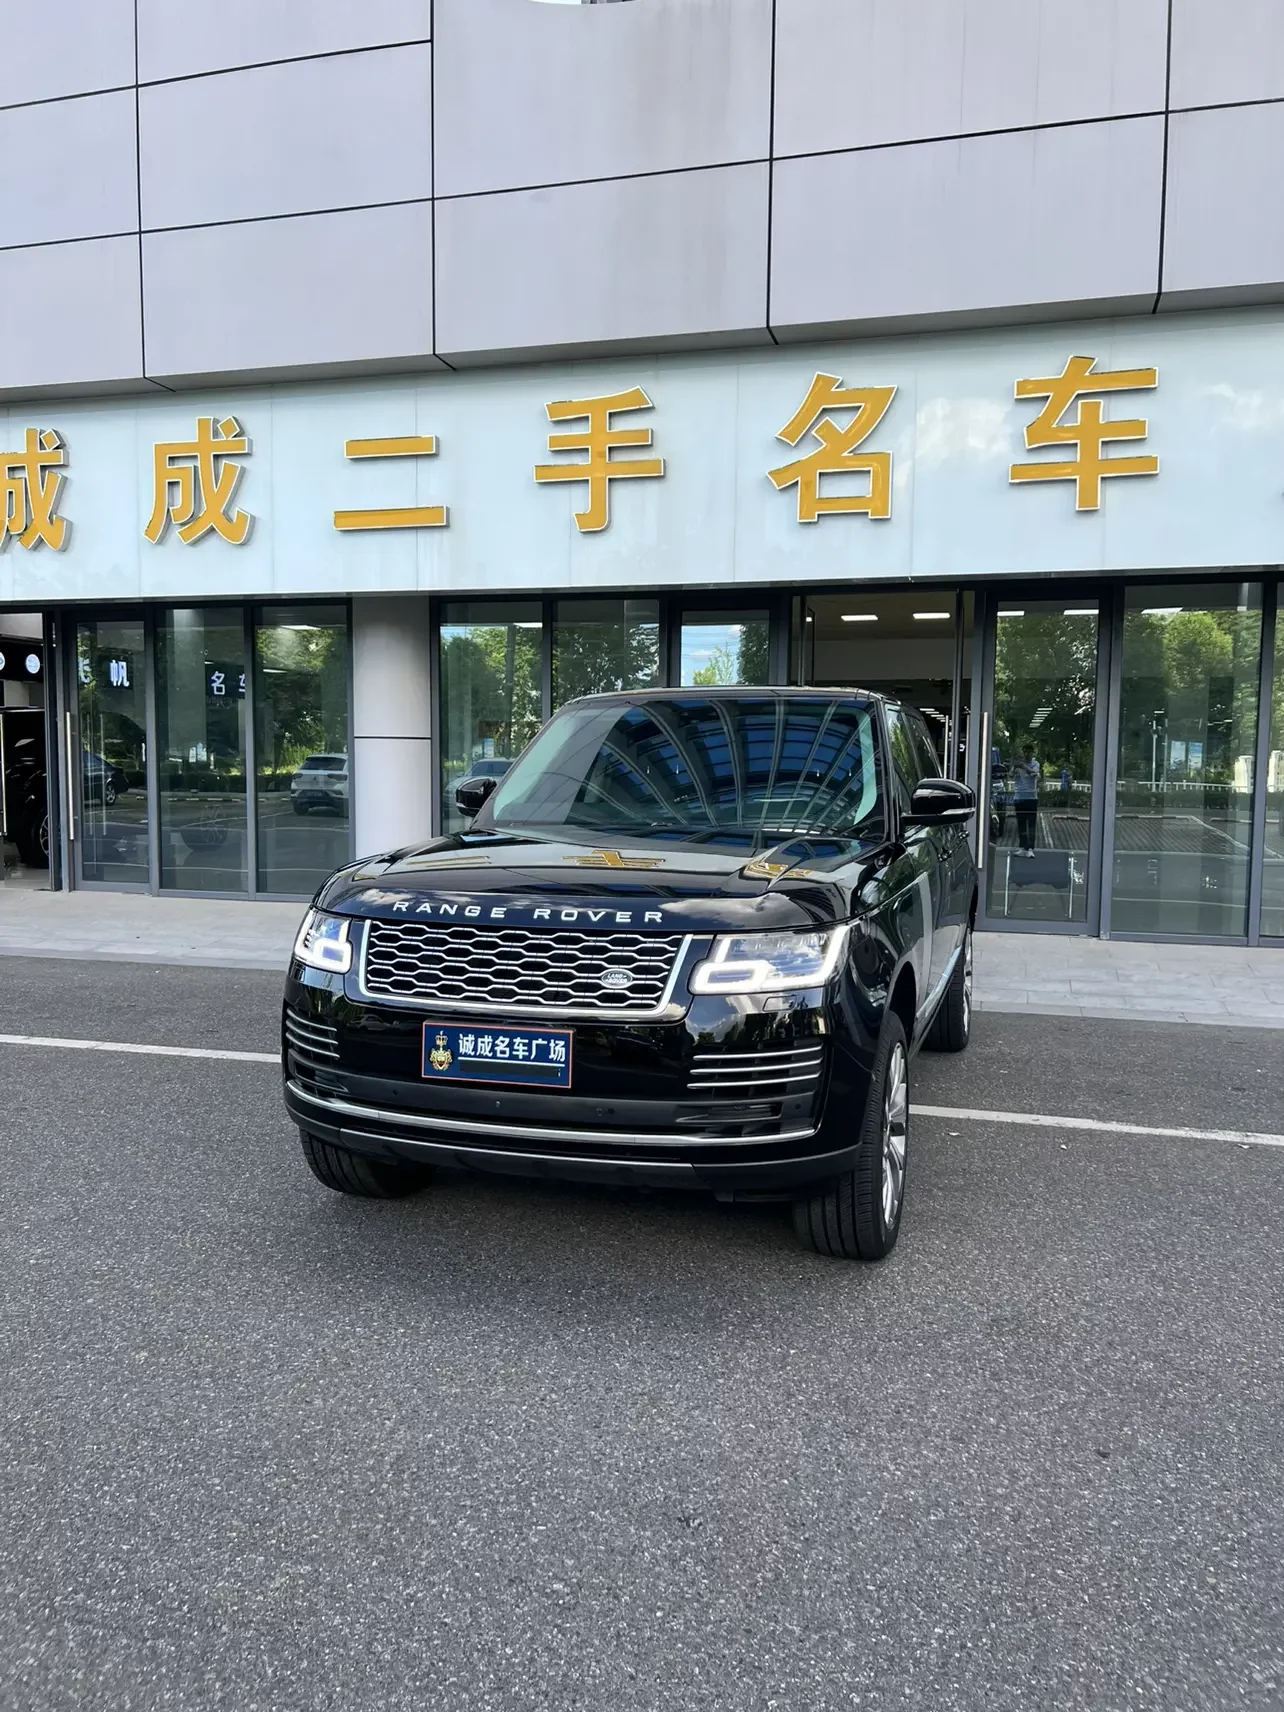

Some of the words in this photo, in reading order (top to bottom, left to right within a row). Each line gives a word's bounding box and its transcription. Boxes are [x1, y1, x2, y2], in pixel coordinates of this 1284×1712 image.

[392, 901, 508, 918] RANGE
[532, 908, 664, 923] ROVER
[458, 1033, 566, 1061] 诚成名车广场
